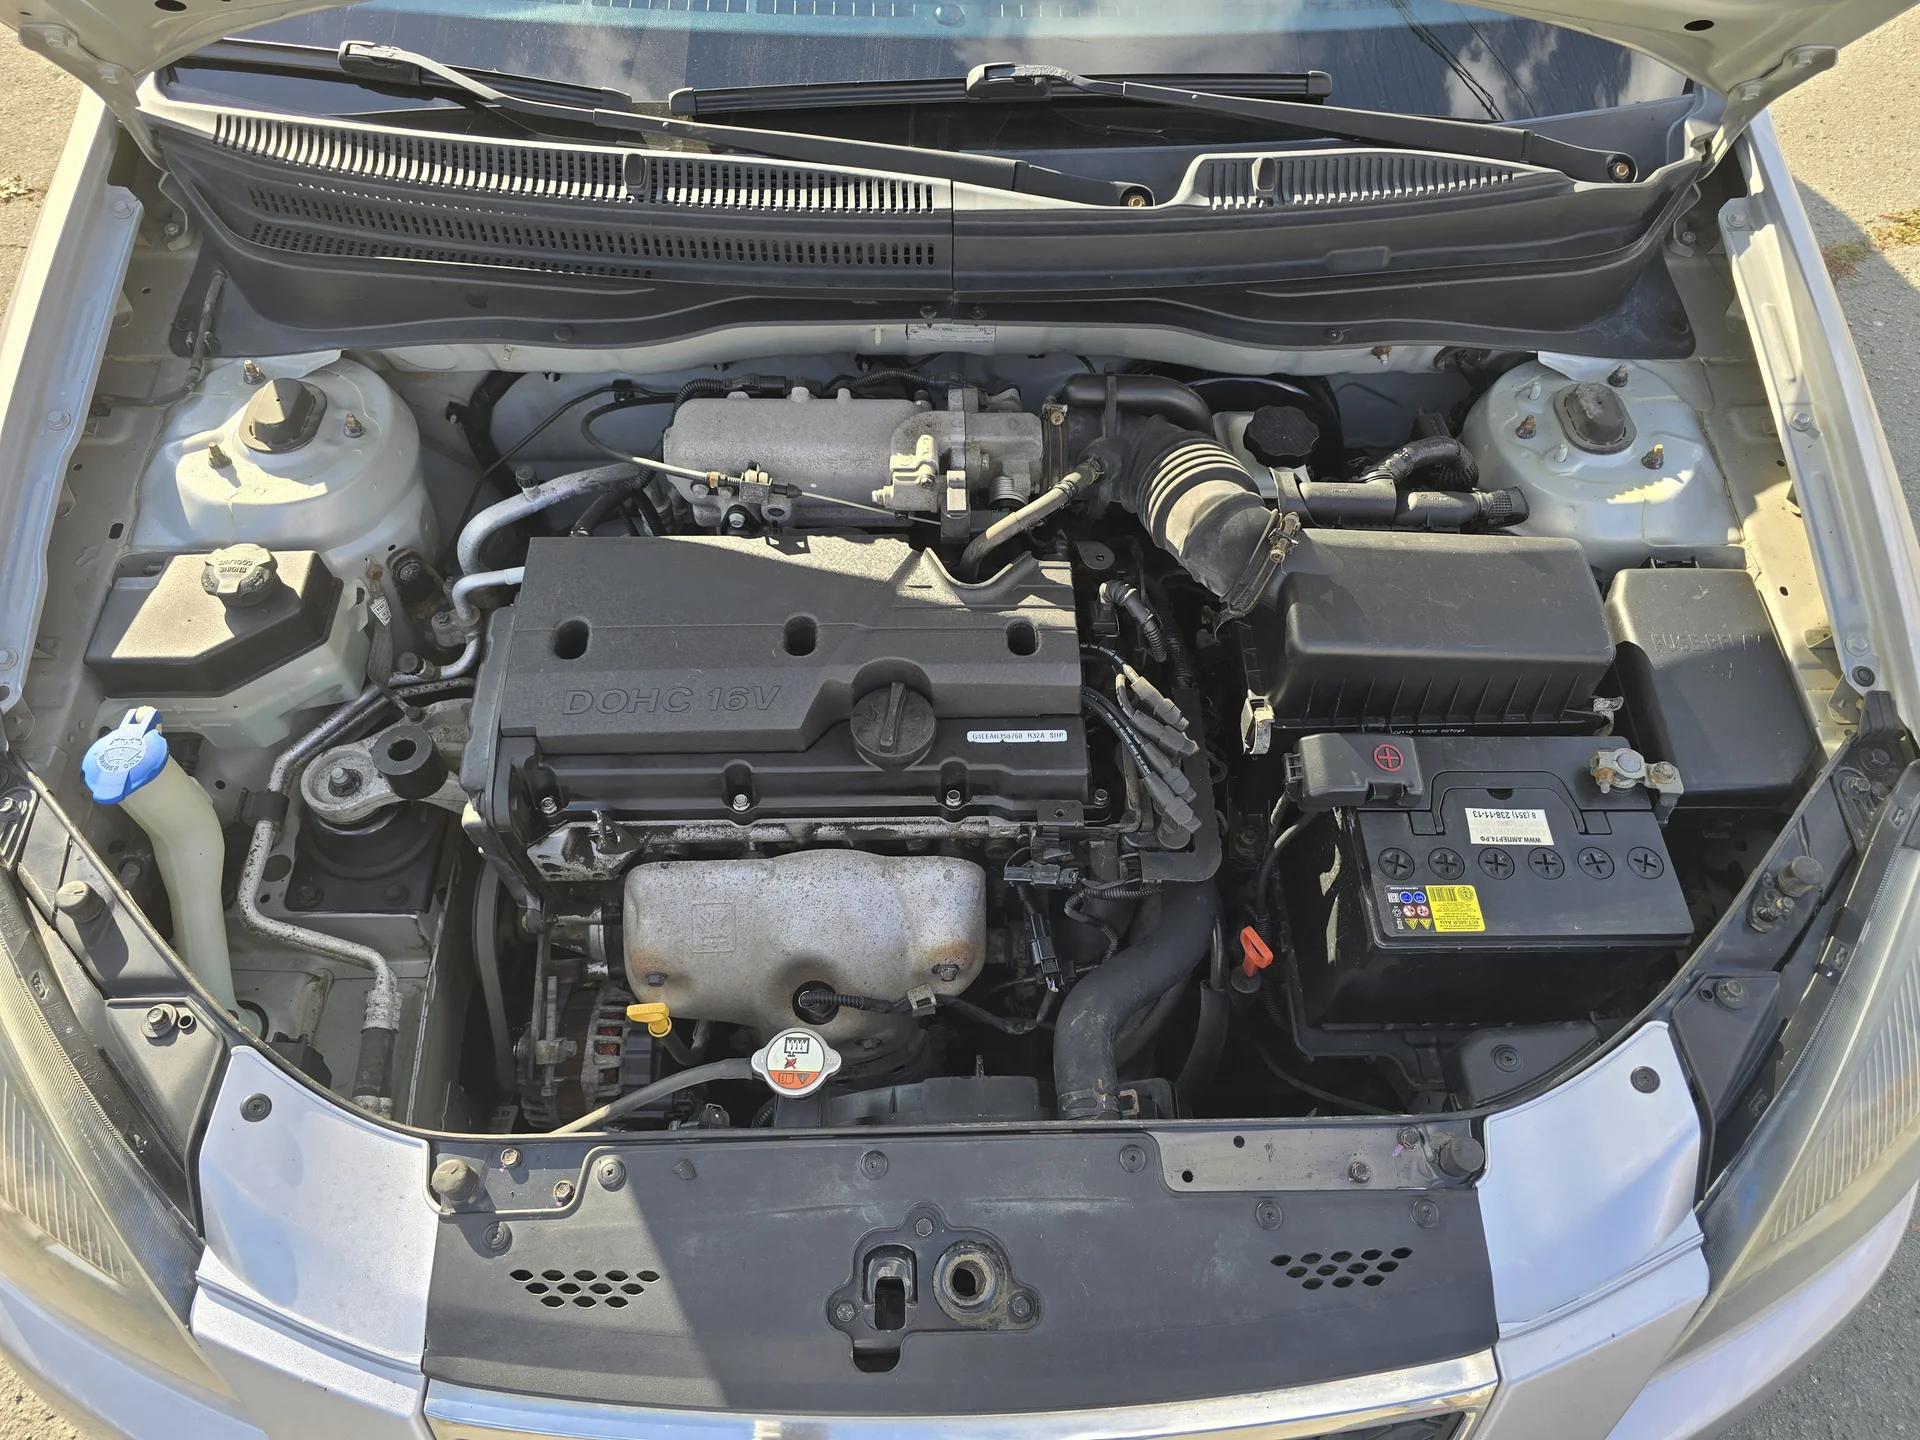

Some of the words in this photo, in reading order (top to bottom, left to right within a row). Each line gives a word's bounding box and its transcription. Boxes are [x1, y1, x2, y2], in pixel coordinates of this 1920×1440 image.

[562, 687, 693, 715] DOHC
[707, 685, 781, 712] 16V
[1472, 810, 1511, 819] 238-11-13
[1511, 810, 1530, 819] (351)
[1531, 811, 1537, 819] 8
